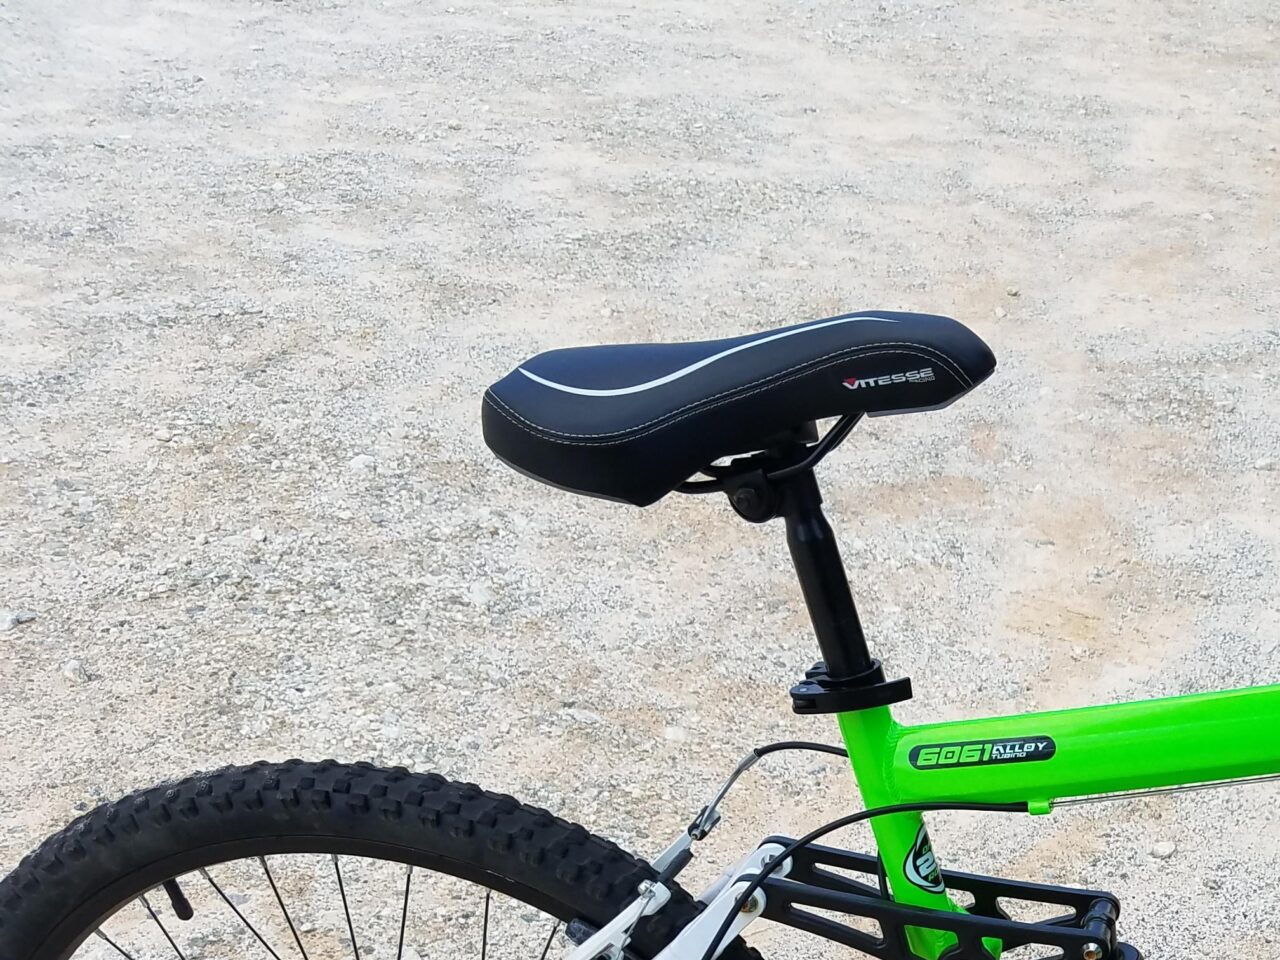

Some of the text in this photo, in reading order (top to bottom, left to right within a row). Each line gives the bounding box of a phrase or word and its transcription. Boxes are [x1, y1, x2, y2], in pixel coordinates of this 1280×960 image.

[841, 367, 934, 390] VITESSE
[916, 741, 1048, 766] 6061 ALLOY
